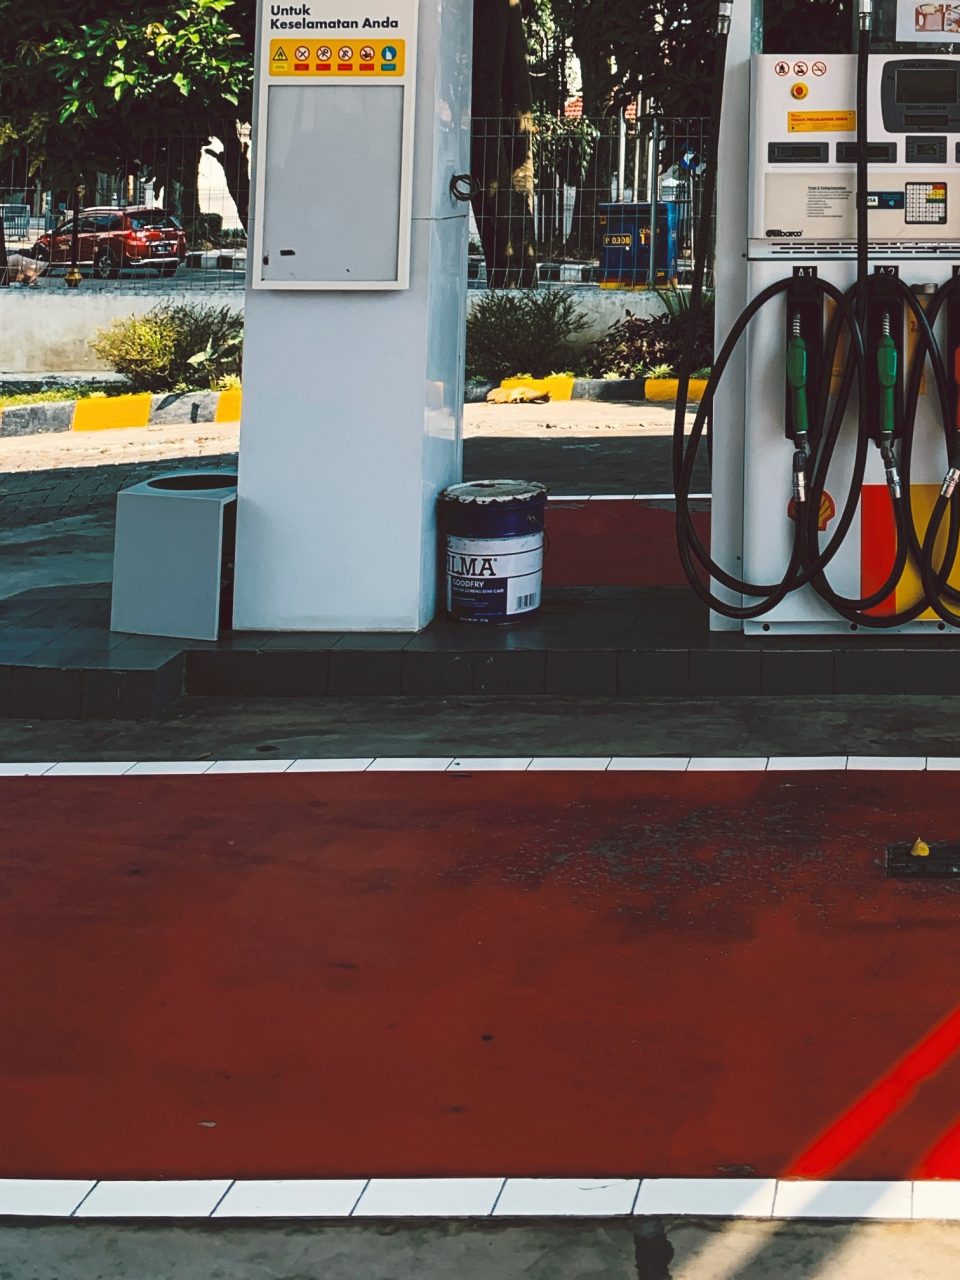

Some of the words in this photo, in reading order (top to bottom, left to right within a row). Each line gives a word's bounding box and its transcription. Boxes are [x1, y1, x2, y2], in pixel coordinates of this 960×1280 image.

[270, 4, 311, 16] Untuk
[270, 17, 359, 30] Keselamatan
[362, 16, 399, 29] Anda
[449, 555, 497, 577] LMA
